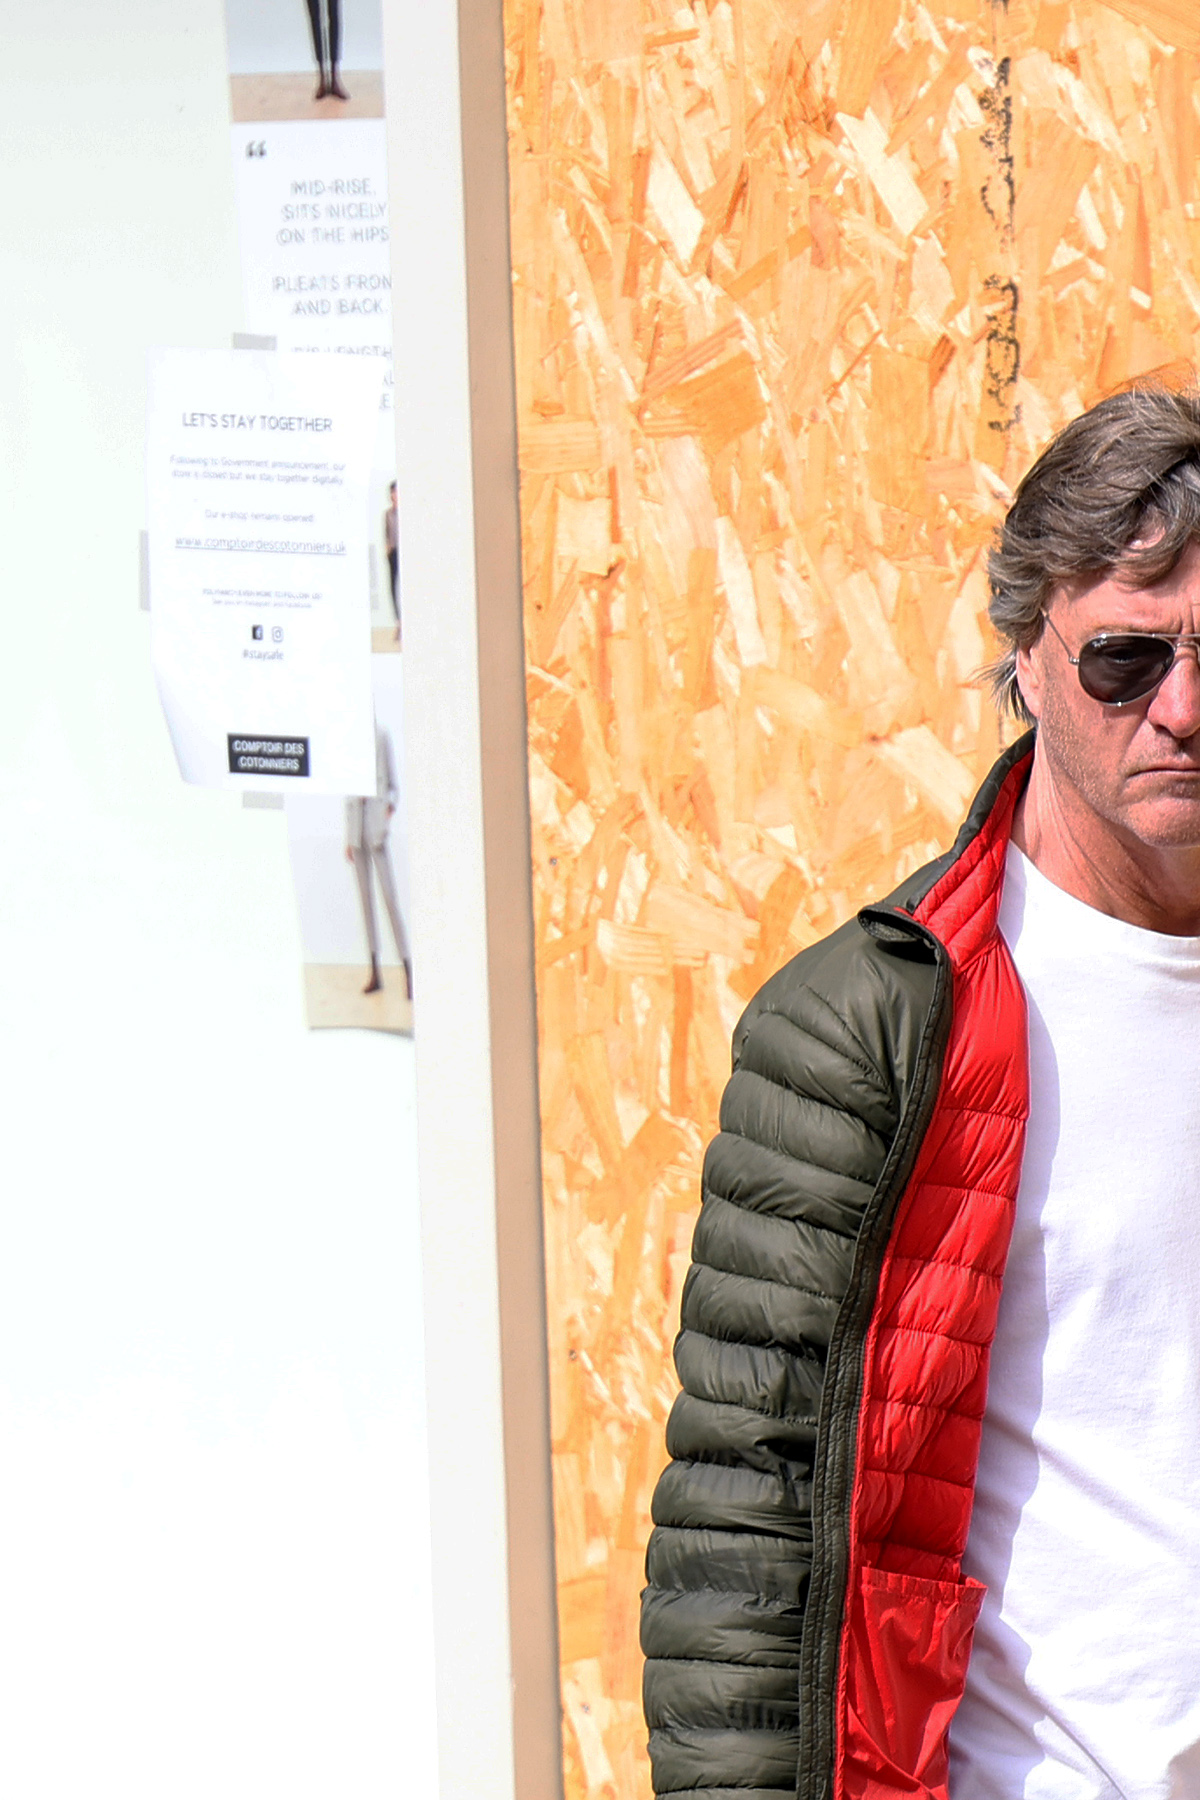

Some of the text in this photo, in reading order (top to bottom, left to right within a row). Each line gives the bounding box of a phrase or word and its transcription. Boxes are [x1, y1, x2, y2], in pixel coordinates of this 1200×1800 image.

[281, 202, 387, 221] SITS NICELY
[277, 226, 390, 246] ON THE HIPS
[272, 275, 340, 293] PLEATS
[292, 299, 331, 316] AND
[221, 413, 257, 429] STAY
[260, 415, 333, 432] TOGETHER
[234, 740, 305, 755] COMPTOIR DES
[240, 756, 299, 771] COTONNIERS
